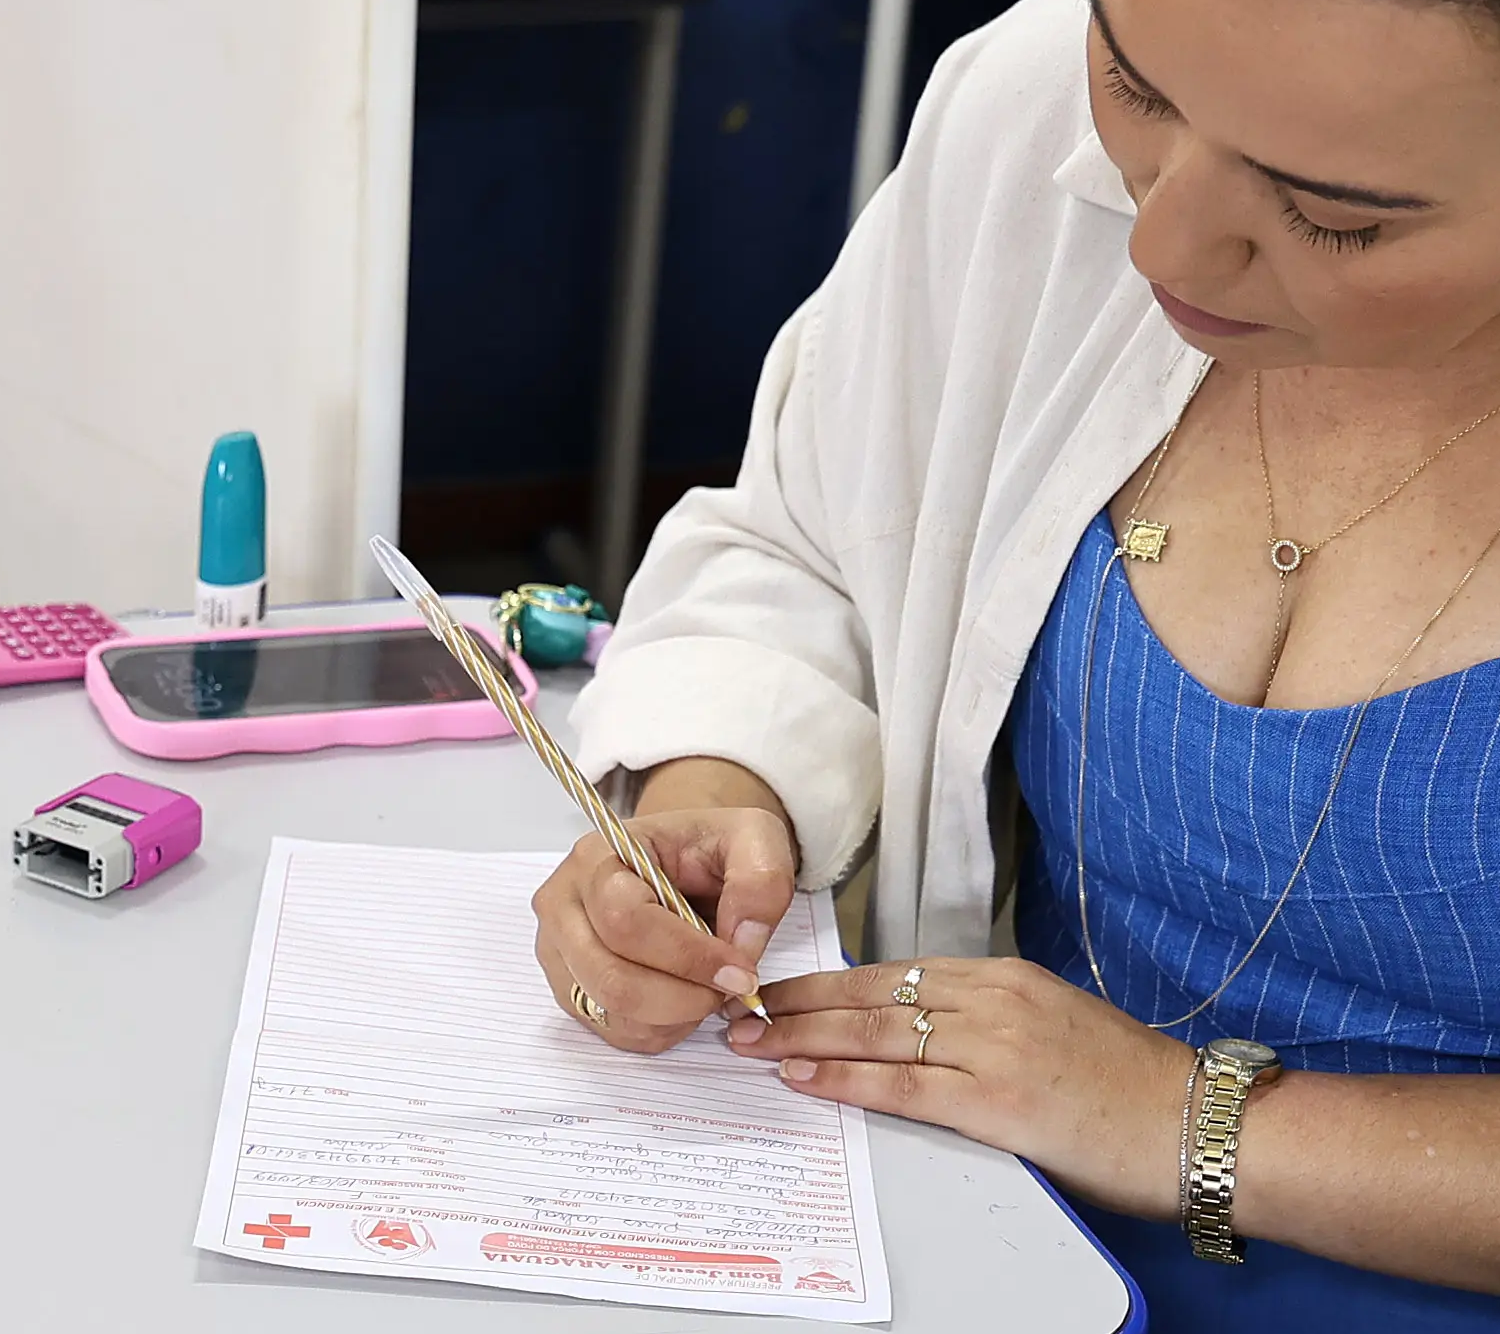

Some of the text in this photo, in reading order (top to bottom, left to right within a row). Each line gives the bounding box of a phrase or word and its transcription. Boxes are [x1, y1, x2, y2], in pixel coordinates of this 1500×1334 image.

[763, 1125, 838, 1141] ANTECEDENTES
[418, 1169, 466, 1181] CONTATO:
[357, 1177, 465, 1193] DATA DE NASCIMENTO:
[294, 1199, 382, 1213] EMERGÊNCIA
[548, 1199, 581, 1207] IDADE:
[407, 1209, 478, 1224] URGÊNCIA
[480, 1217, 499, 1226] DE
[502, 1220, 596, 1237] ATENDIMENTO
[506, 1240, 534, 1250] POVO
[598, 1231, 726, 1249] ENCAMINHAMENTO
[536, 1243, 550, 1251] DO
[551, 1244, 585, 1255] FORÇA
[592, 1248, 615, 1256] COM
[751, 1244, 792, 1252] FICHA
[482, 1251, 610, 1269] ARAGUAIA
[615, 1250, 675, 1261] CRESCENDO
[655, 1265, 723, 1278] Jesus
[727, 1270, 783, 1283] Bom
[634, 1272, 782, 1290] PREFEITURA MUNICIPAL DE
